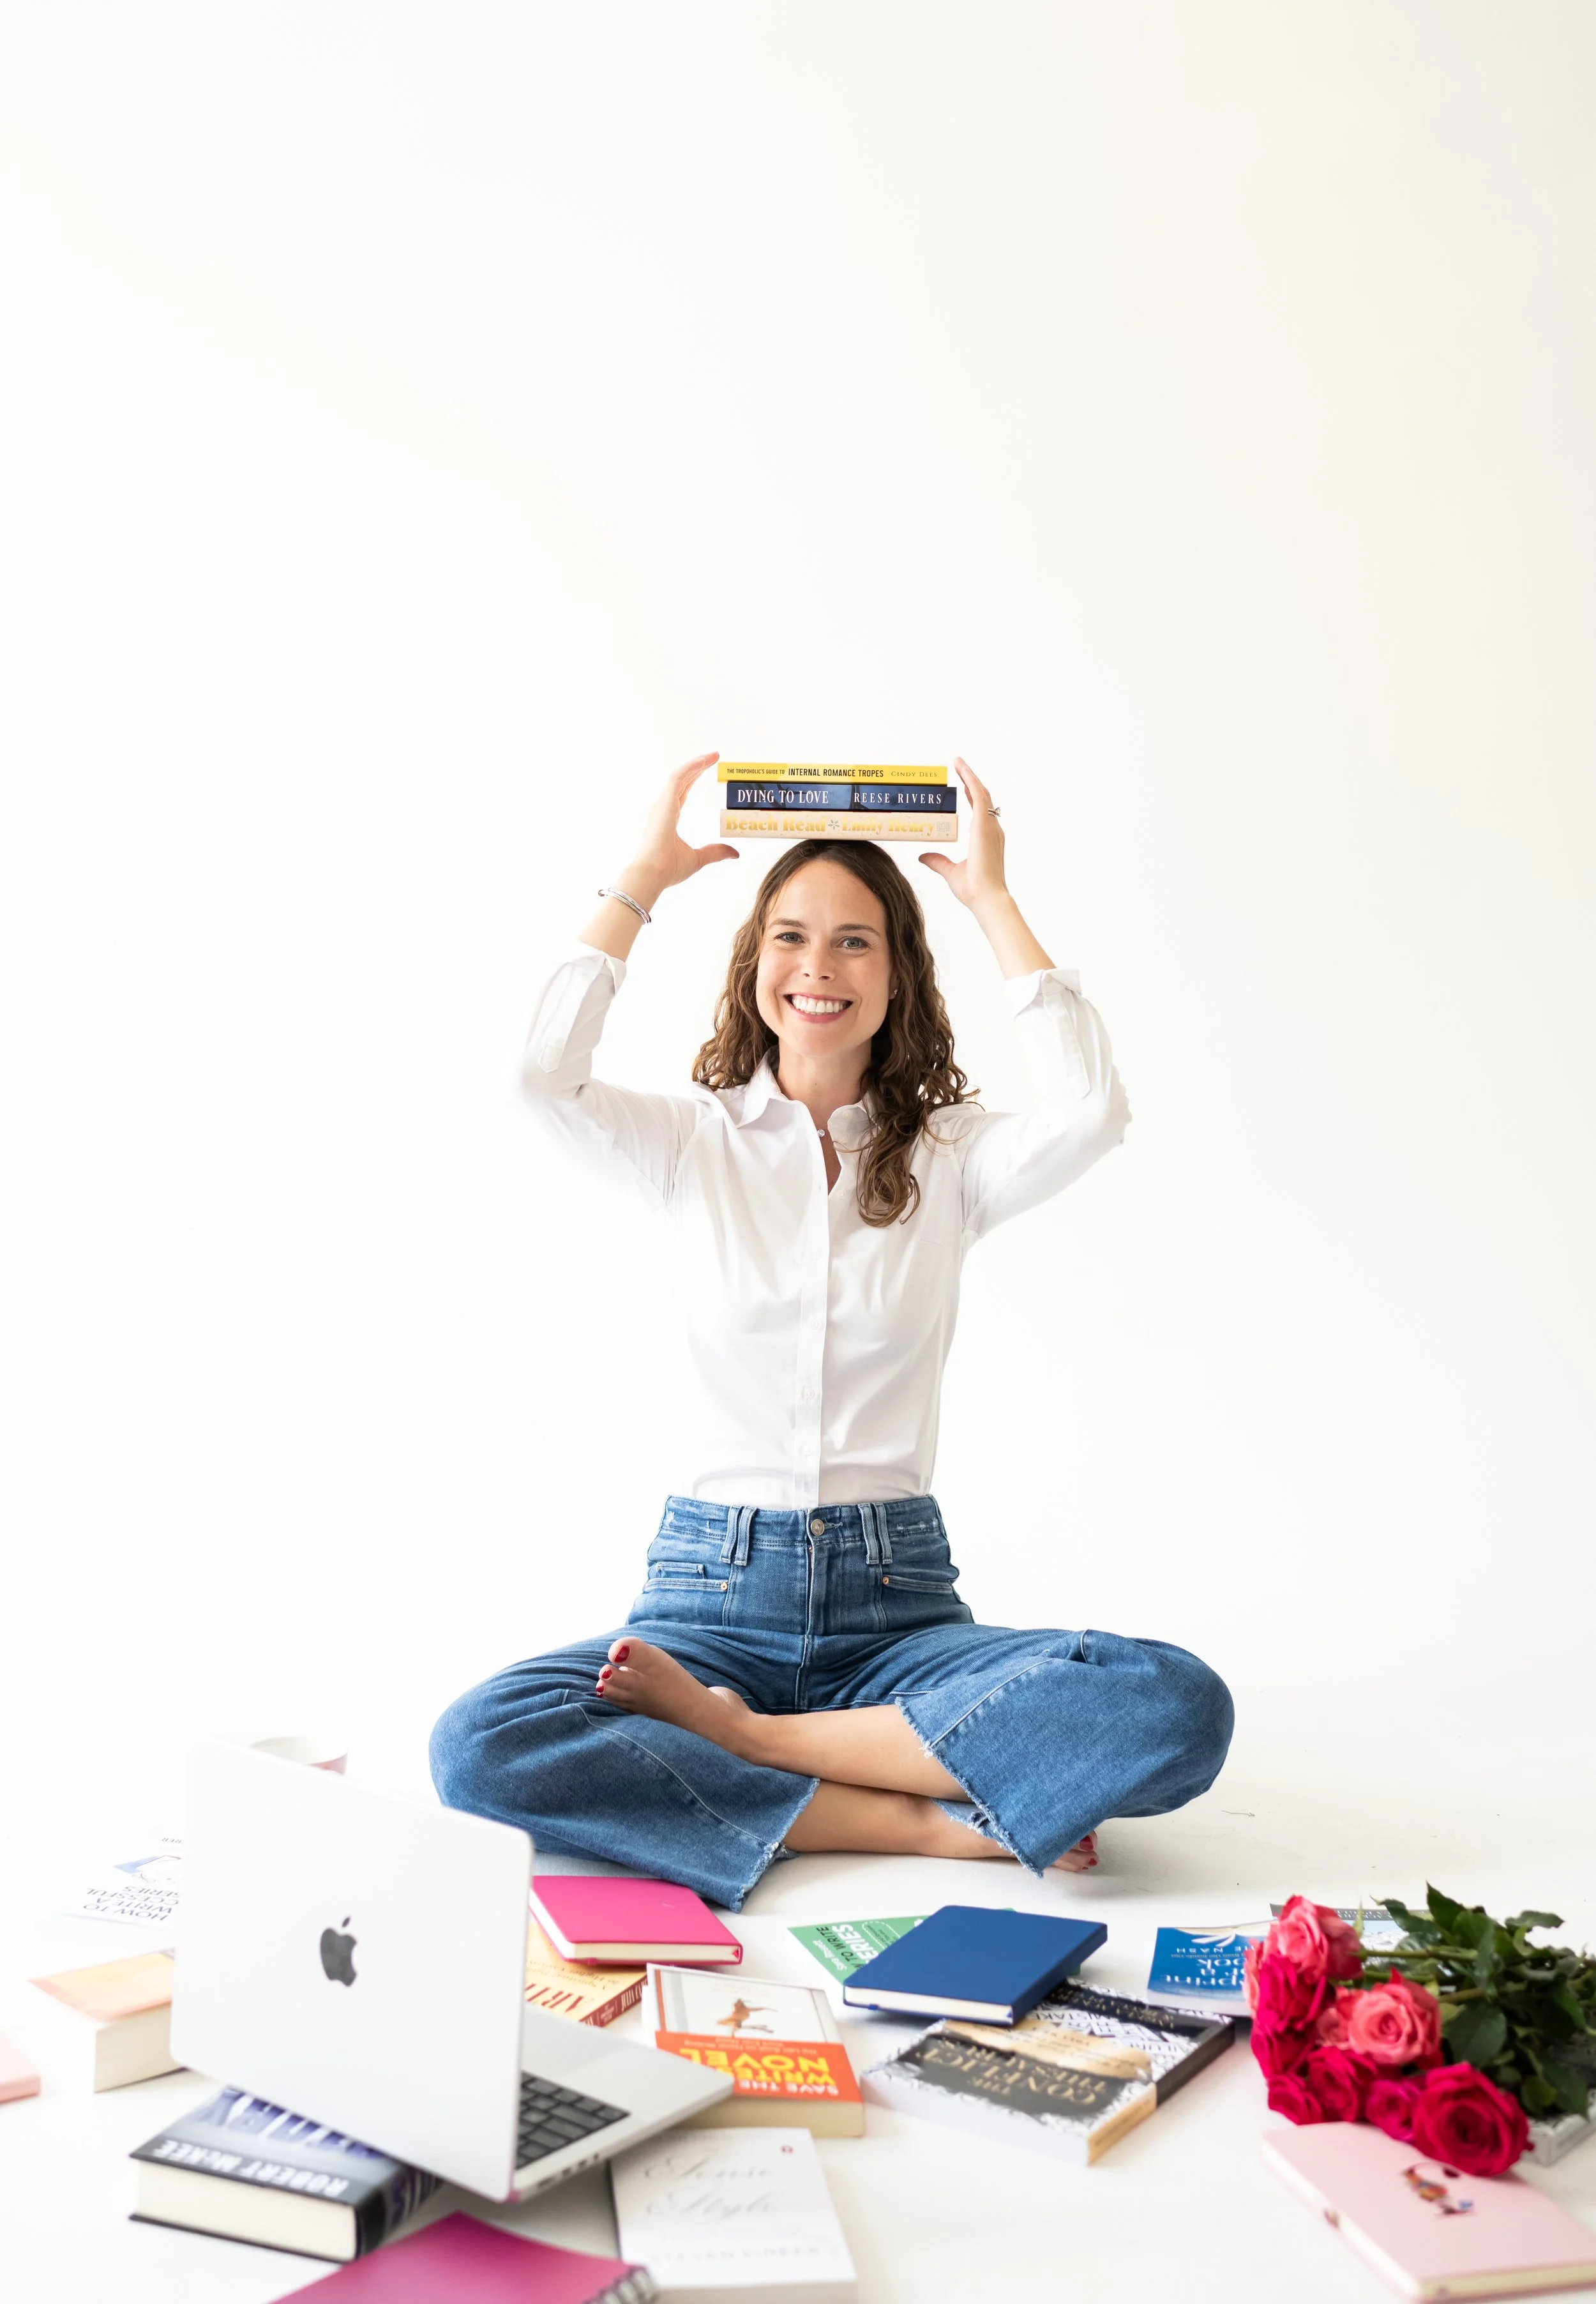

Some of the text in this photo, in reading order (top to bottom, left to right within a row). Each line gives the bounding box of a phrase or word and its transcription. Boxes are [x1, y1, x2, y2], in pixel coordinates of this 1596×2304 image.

[788, 768, 821, 777] INTERNAL
[823, 768, 855, 777] ROMANCE
[737, 789, 942, 804] DYING TO LOVE REESE RIVERS
[726, 815, 778, 831] Beach
[783, 815, 826, 831] Read
[841, 815, 883, 835] Emily
[888, 817, 935, 836] Henry
[87, 1888, 179, 1905] CCESSFUL
[83, 1904, 168, 1920] HOW TO
[112, 1900, 172, 1914] WRITE
[816, 1926, 858, 1962] TO WRITE
[832, 1924, 879, 1964] ERIES
[1196, 1957, 1247, 1970] ook
[1160, 1974, 1244, 1987] print
[679, 2047, 830, 2073] NOVEL
[915, 2048, 1096, 2104] CONFLICT
[739, 2079, 839, 2096] SAVE THE
[240, 2160, 350, 2198] ROBERT
